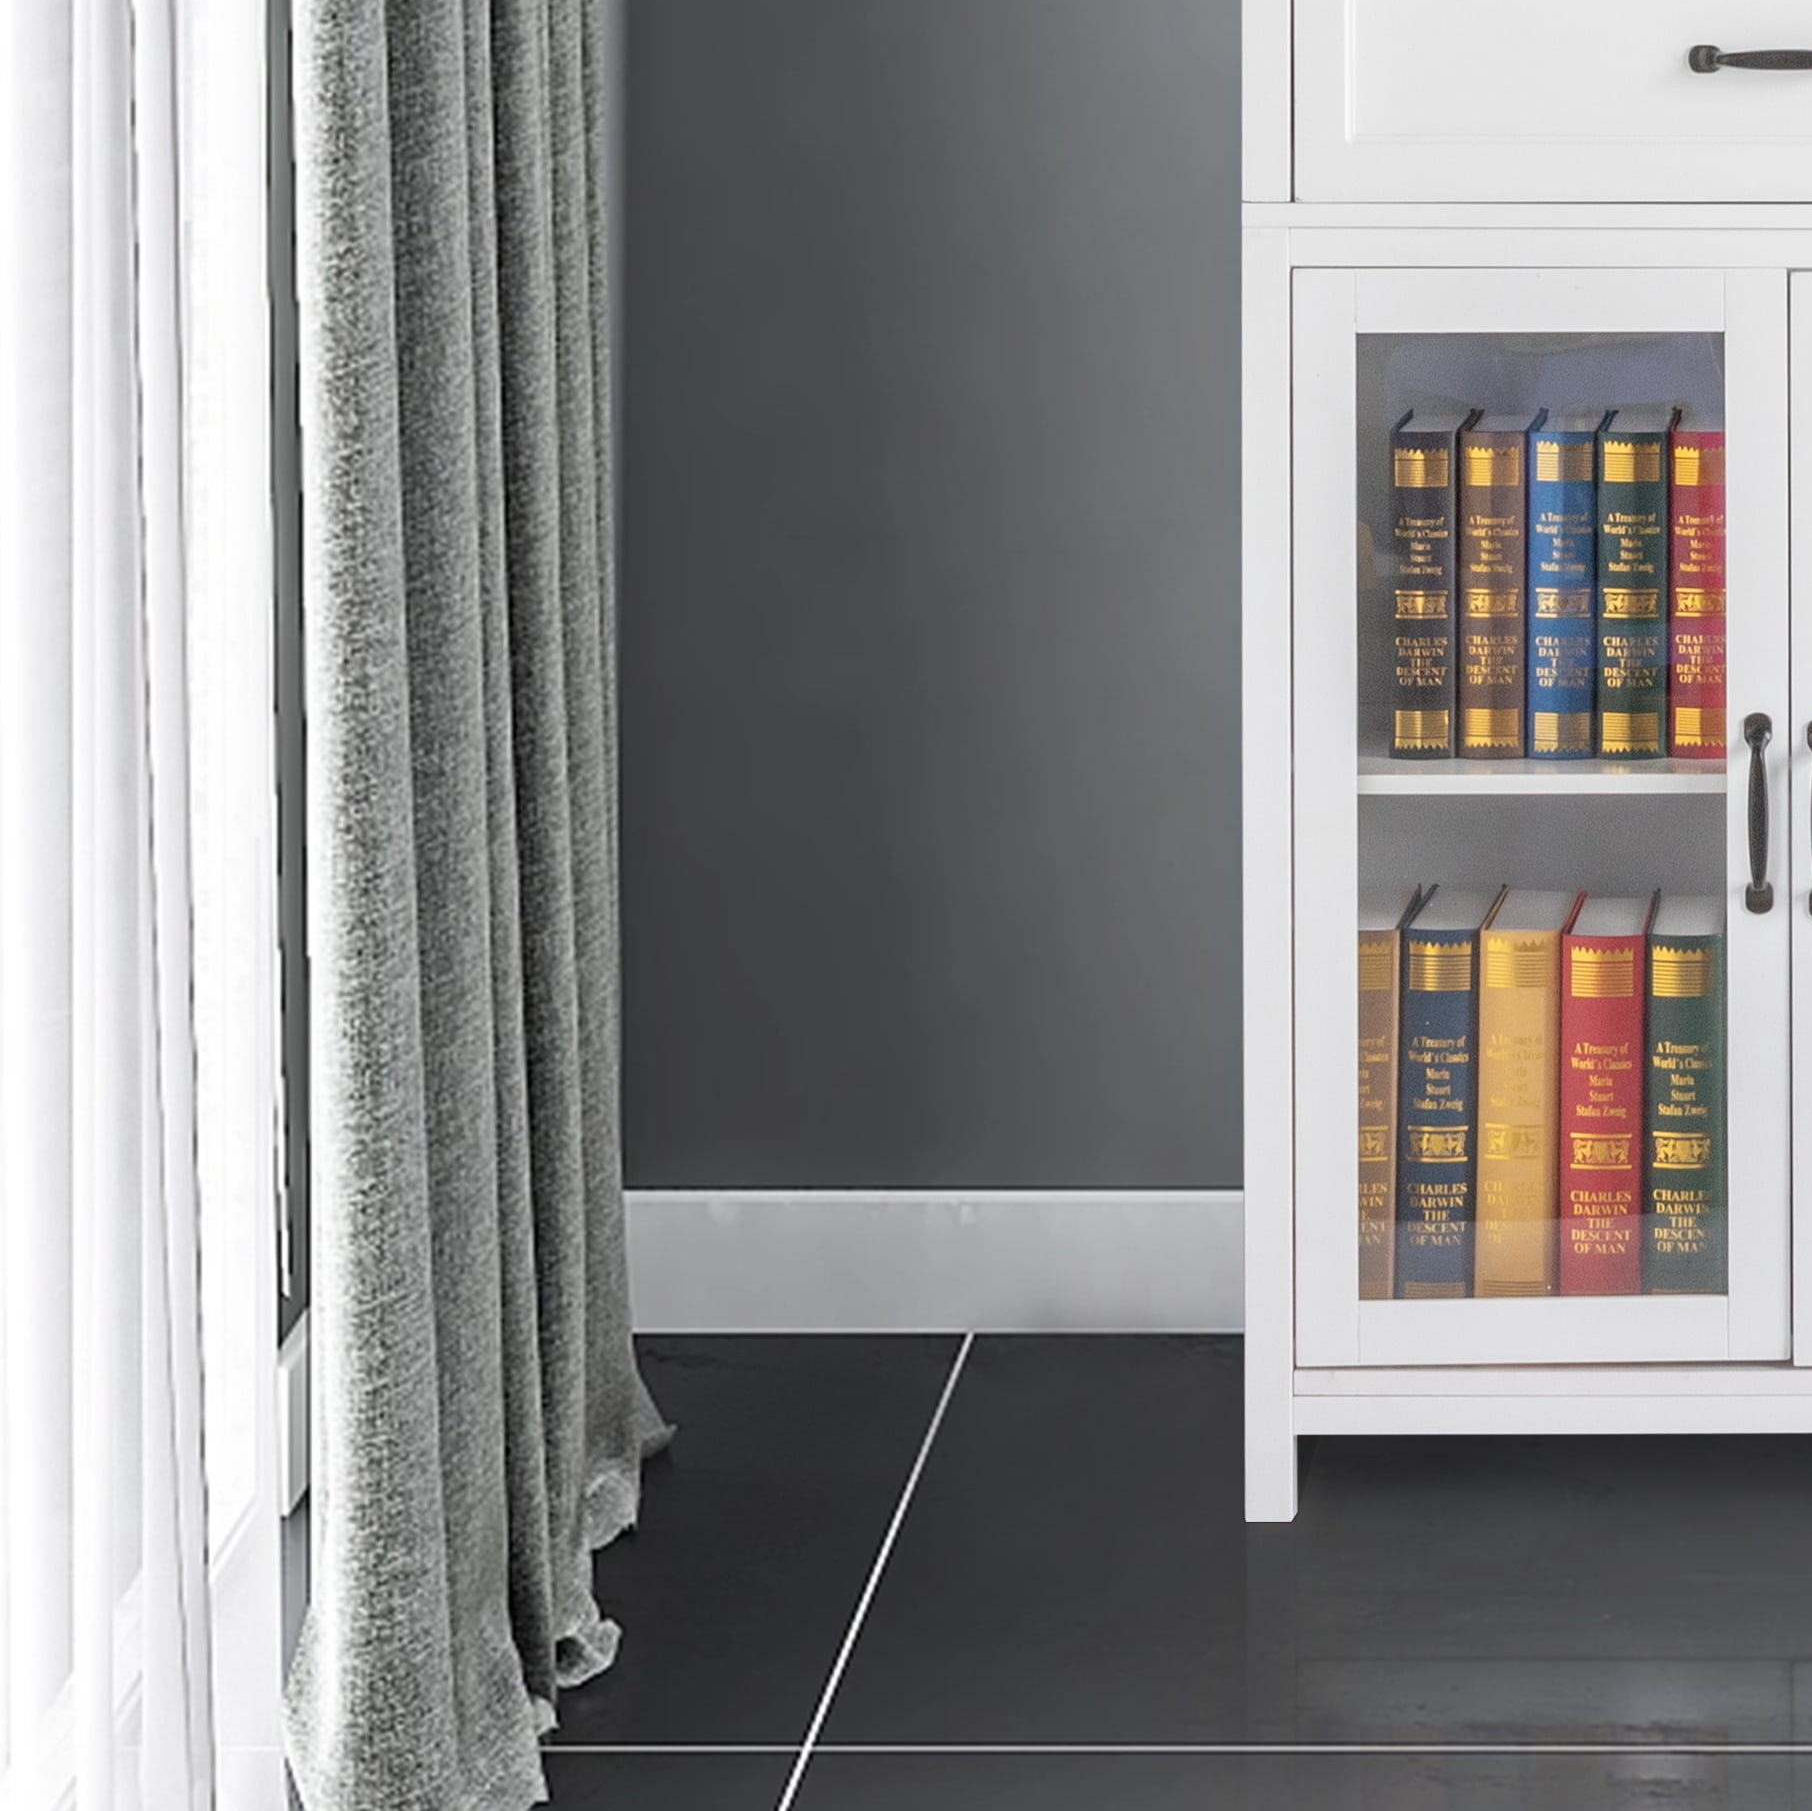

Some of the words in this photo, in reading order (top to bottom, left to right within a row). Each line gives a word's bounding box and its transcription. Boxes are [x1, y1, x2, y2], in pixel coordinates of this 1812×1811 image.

[1395, 637, 1448, 646] CHARLES
[1399, 648, 1444, 657] DARWIN
[1400, 677, 1412, 685] OF
[1469, 676, 1483, 685] OF
[1539, 678, 1555, 687] OF
[1607, 678, 1623, 687] OF
[1680, 674, 1694, 683] OF
[1575, 1044, 1582, 1053] A
[1656, 1043, 1663, 1053] A
[1407, 1183, 1467, 1194] CHARLES
[1411, 1196, 1463, 1207] DARWIN
[1570, 1191, 1631, 1202] CHARLES
[1574, 1204, 1627, 1215] DARWIN
[1423, 1210, 1449, 1221] THE
[1587, 1217, 1614, 1229] THE
[1669, 1216, 1696, 1228] THE
[1408, 1222, 1466, 1233] DESCENT
[1571, 1229, 1632, 1241] DESCENT
[1410, 1236, 1427, 1246] OF
[1432, 1236, 1461, 1246] MAN
[1574, 1243, 1590, 1253] OF
[1594, 1243, 1626, 1253] MAN
[1657, 1241, 1673, 1252] OF
